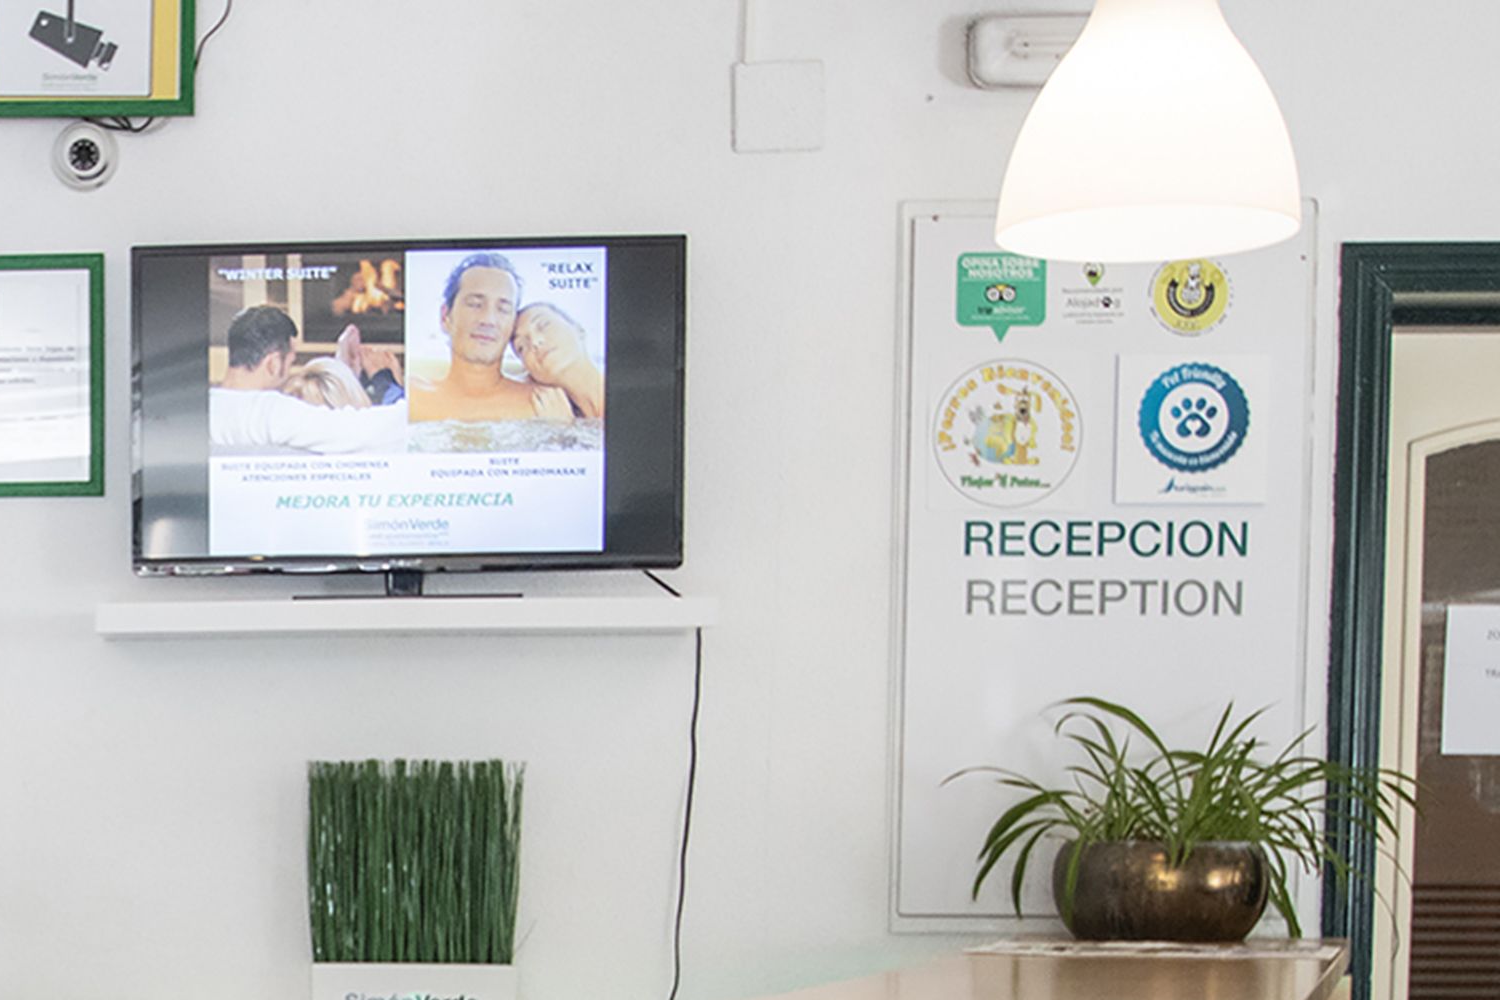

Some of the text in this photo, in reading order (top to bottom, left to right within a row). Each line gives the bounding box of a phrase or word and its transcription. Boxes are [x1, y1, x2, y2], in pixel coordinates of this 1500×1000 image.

[275, 492, 514, 509] MEJORA TU EXPERIENCIA
[963, 520, 1249, 557] RECEPCION
[965, 579, 1244, 616] RECEPTION
